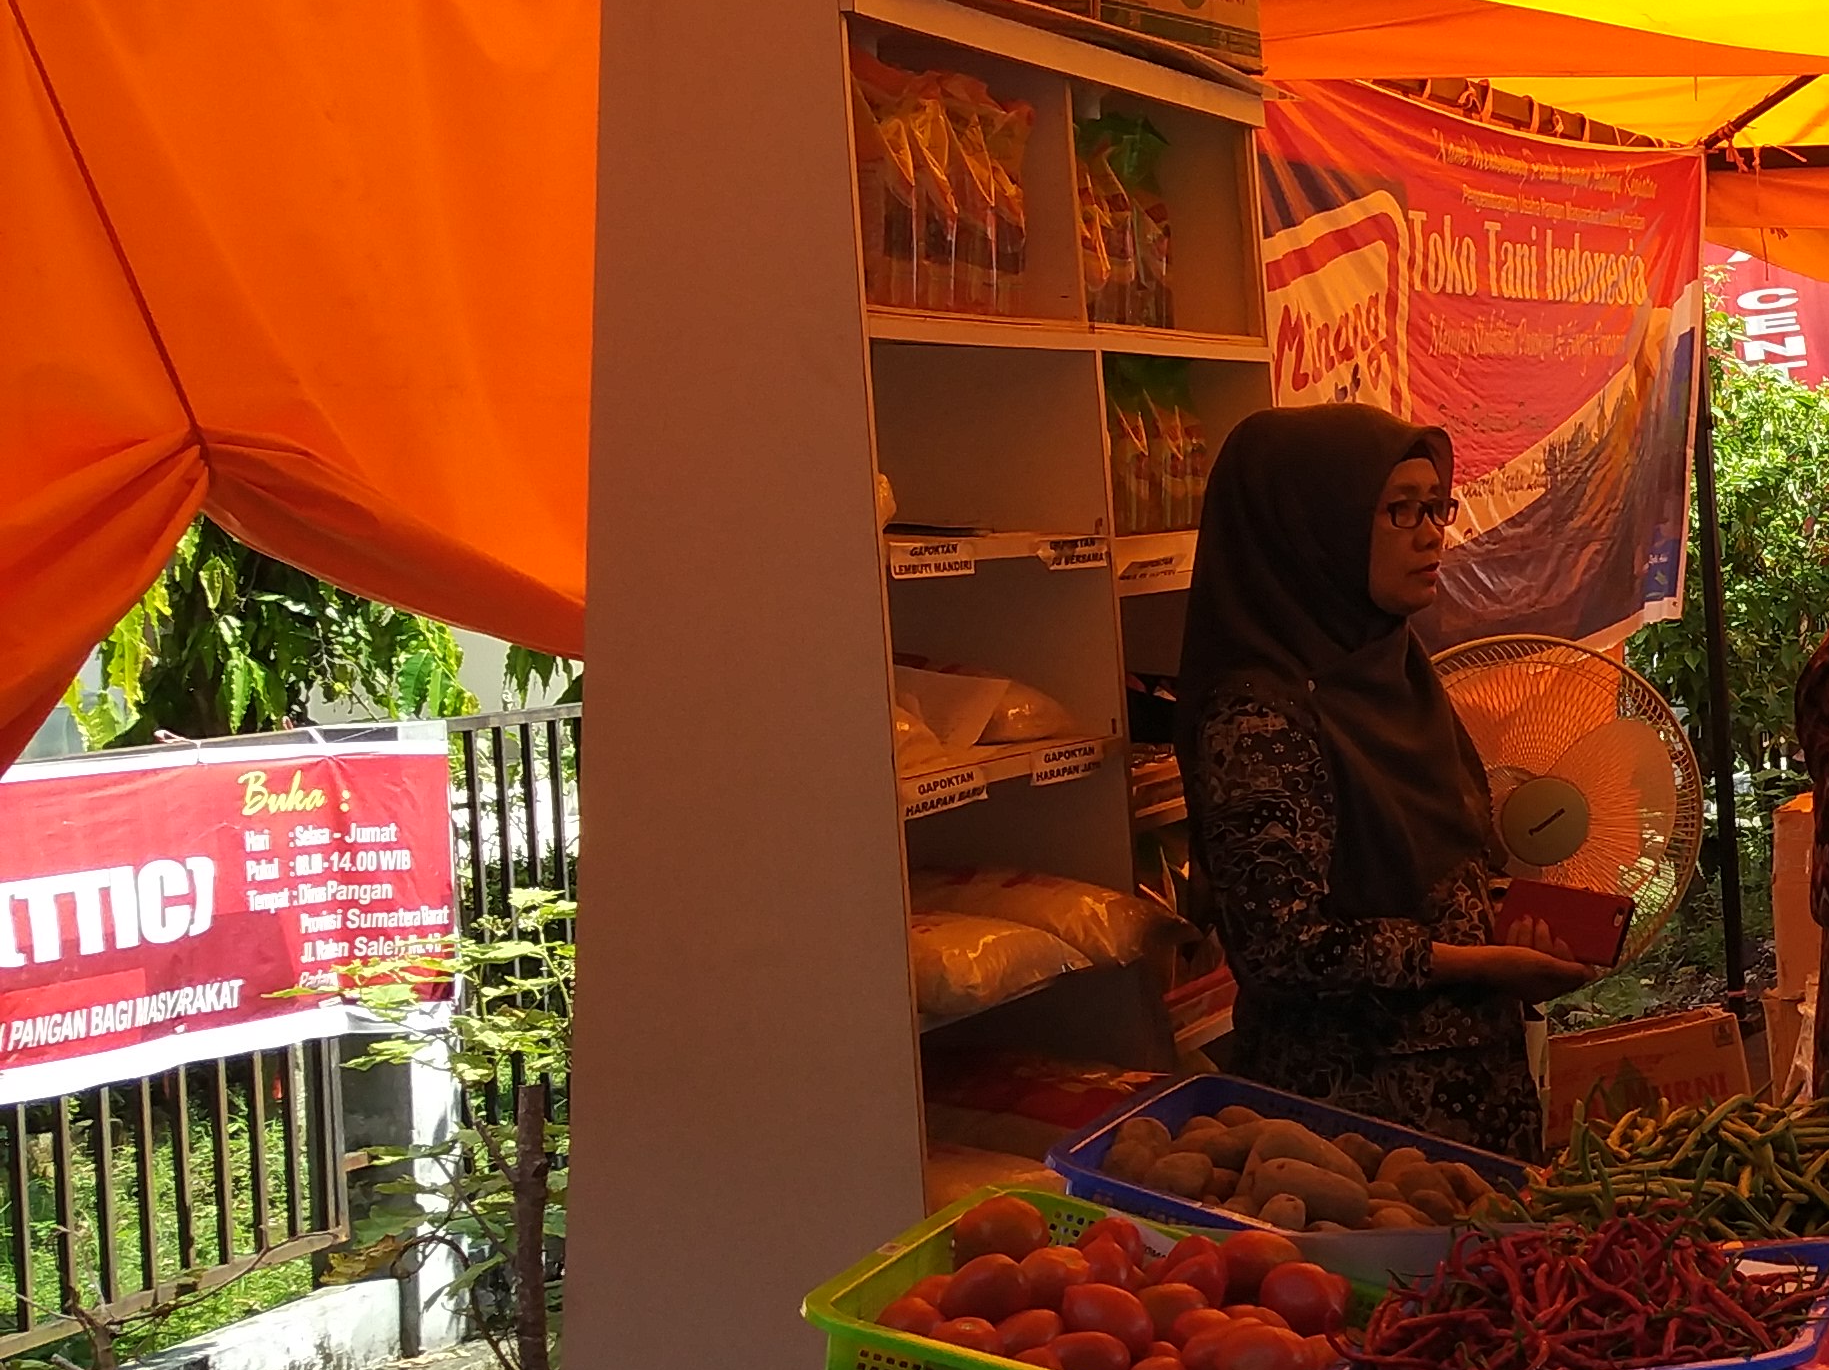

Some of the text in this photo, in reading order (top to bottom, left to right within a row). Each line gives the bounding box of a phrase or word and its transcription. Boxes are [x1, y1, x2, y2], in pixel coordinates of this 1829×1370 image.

[1408, 209, 1649, 307] Toko Tani Indonesia
[237, 769, 326, 816] Buka
[344, 822, 398, 843] Jumat
[330, 851, 379, 872] 14.00
[379, 849, 412, 871] WIB
[327, 880, 393, 905] Pangan
[7, 1008, 90, 1052] PANGAN
[88, 999, 135, 1037] BAGI
